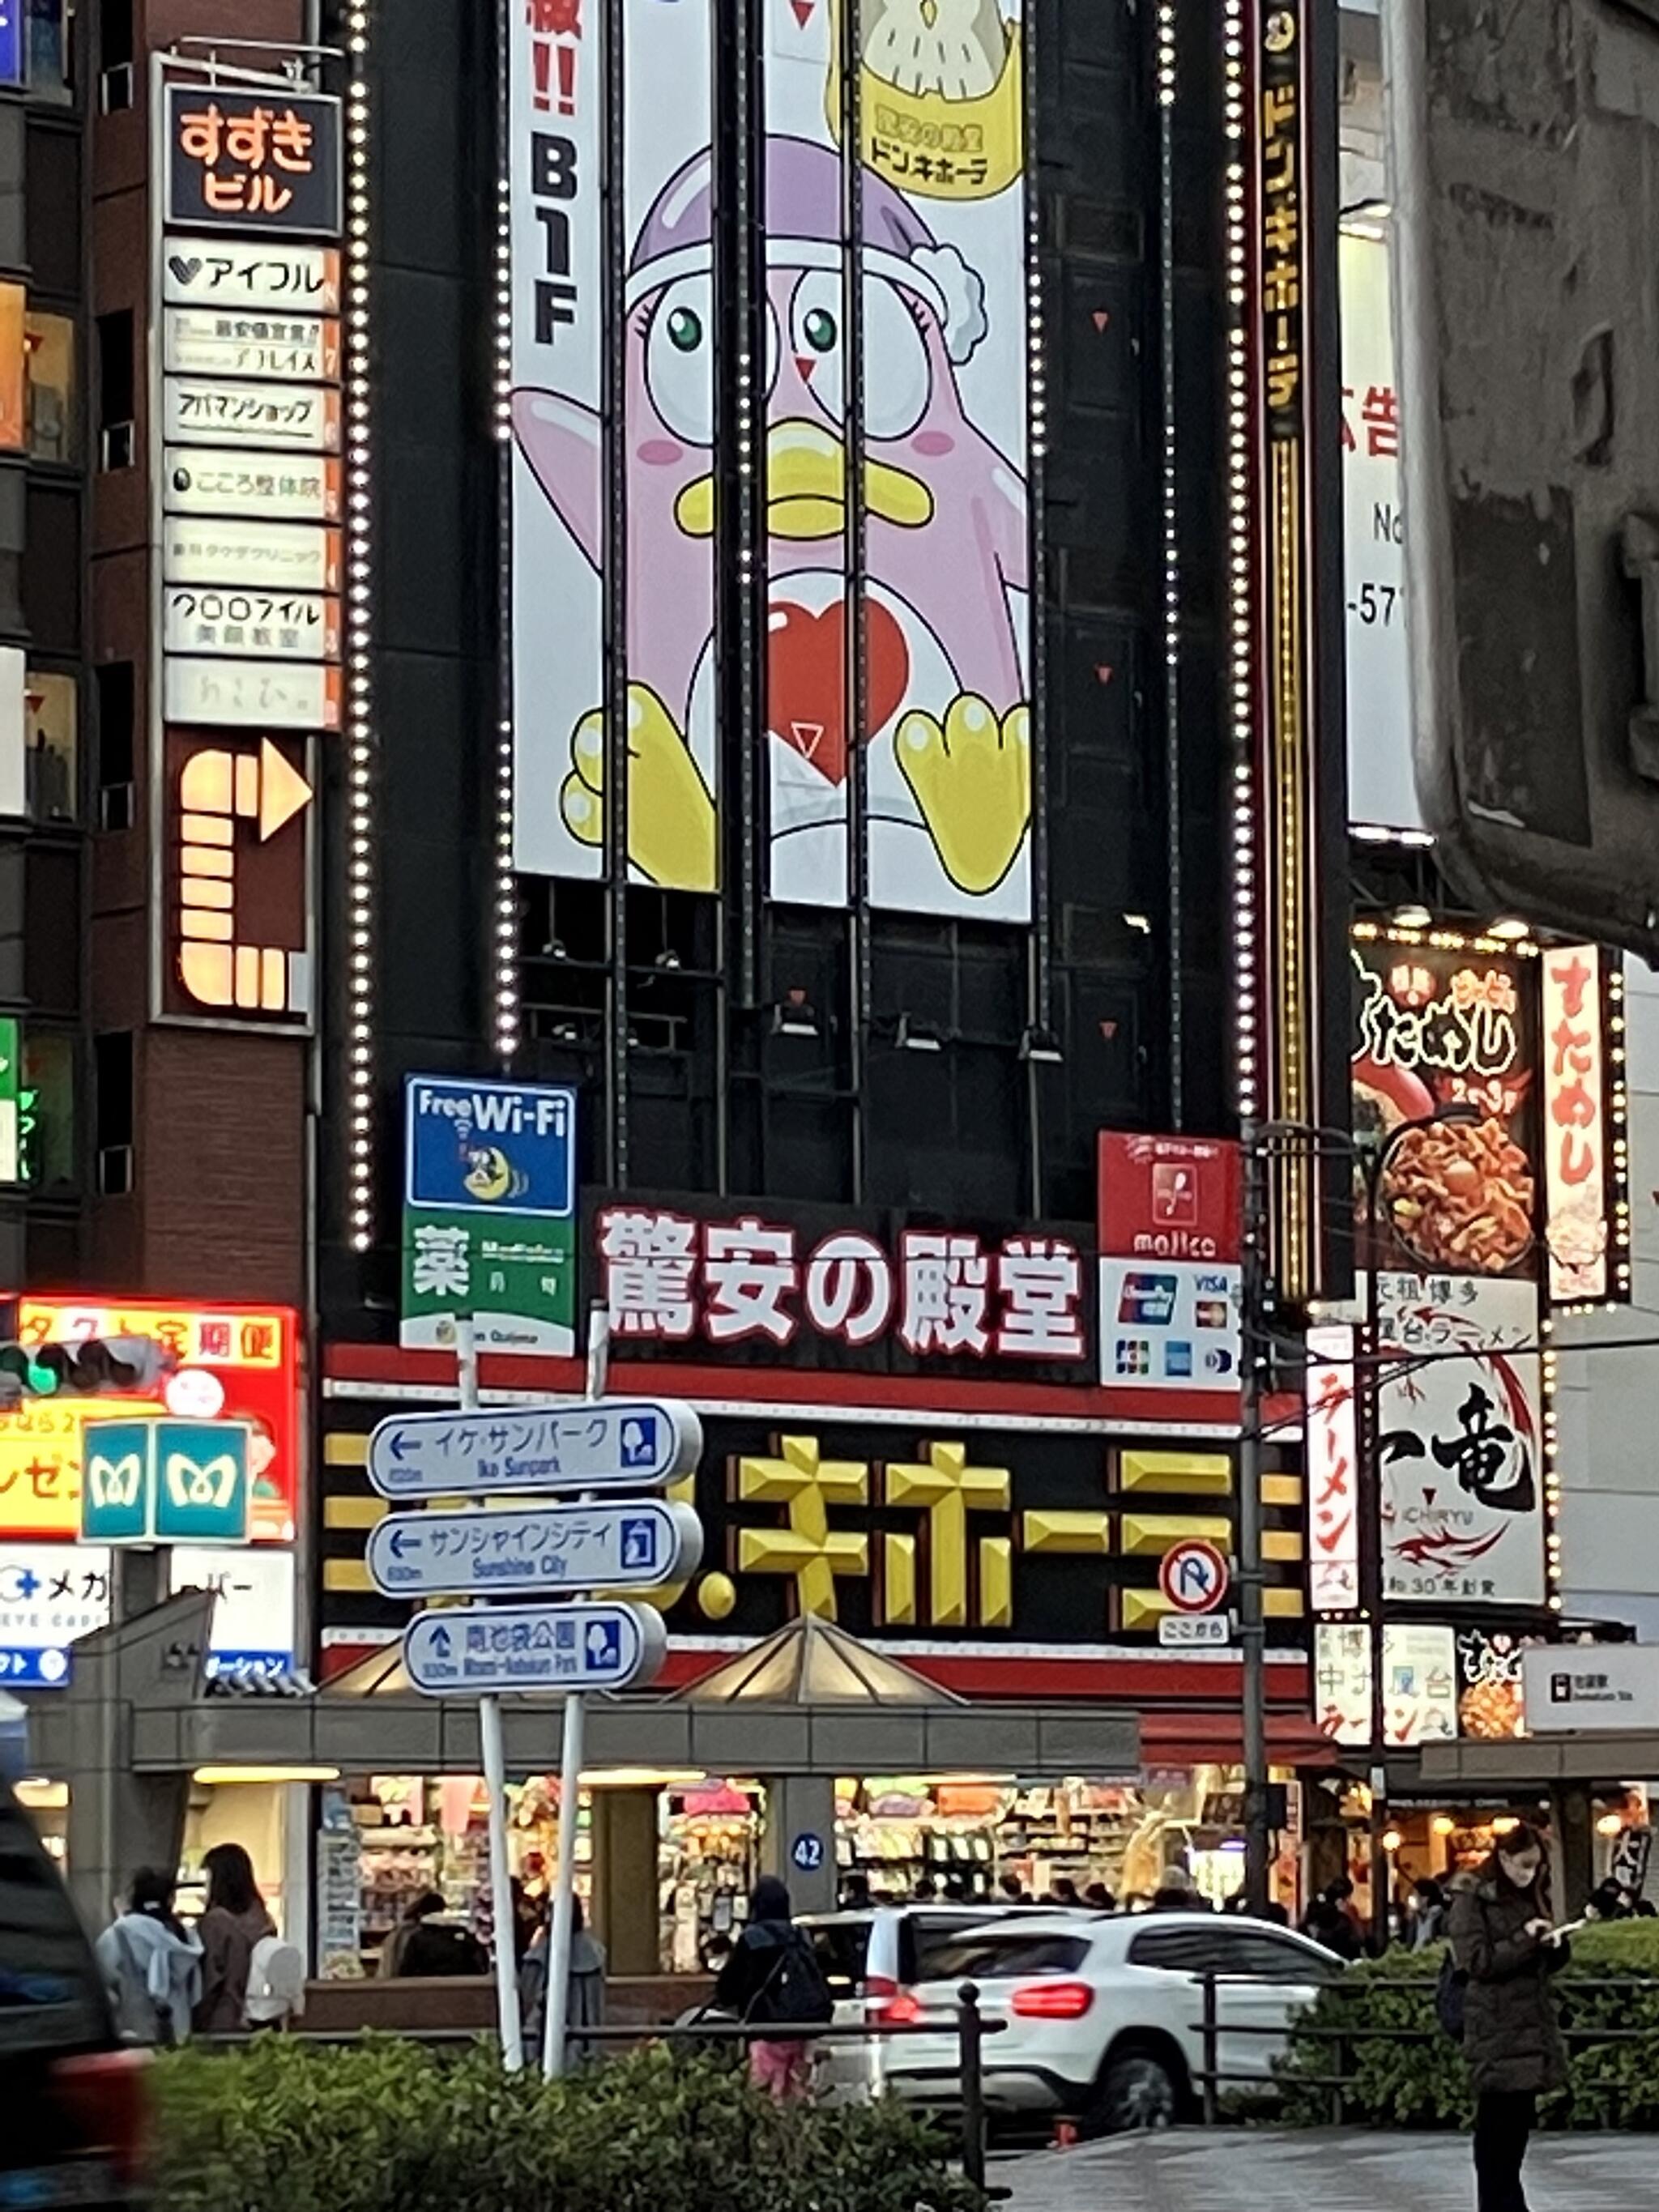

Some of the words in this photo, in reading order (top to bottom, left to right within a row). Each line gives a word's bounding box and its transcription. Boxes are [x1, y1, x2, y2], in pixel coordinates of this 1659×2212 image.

[181, 103, 313, 173] すずき
[205, 172, 292, 212] ビル
[531, 131, 578, 346] B1F
[206, 257, 324, 293] アイフル
[420, 1089, 471, 1118] Free
[472, 1093, 566, 1137] Wi-Fi
[413, 1225, 470, 1297] 薬
[599, 1209, 1083, 1357] 驚安の殿堂
[1194, 1275, 1228, 1294] VISA
[1316, 1373, 1353, 1553] ラーメン
[429, 1522, 612, 1557] サンシャインシティ
[541, 1554, 568, 1579] City
[1165, 1622, 1222, 1639] ここから
[795, 1840, 819, 1865] 42
